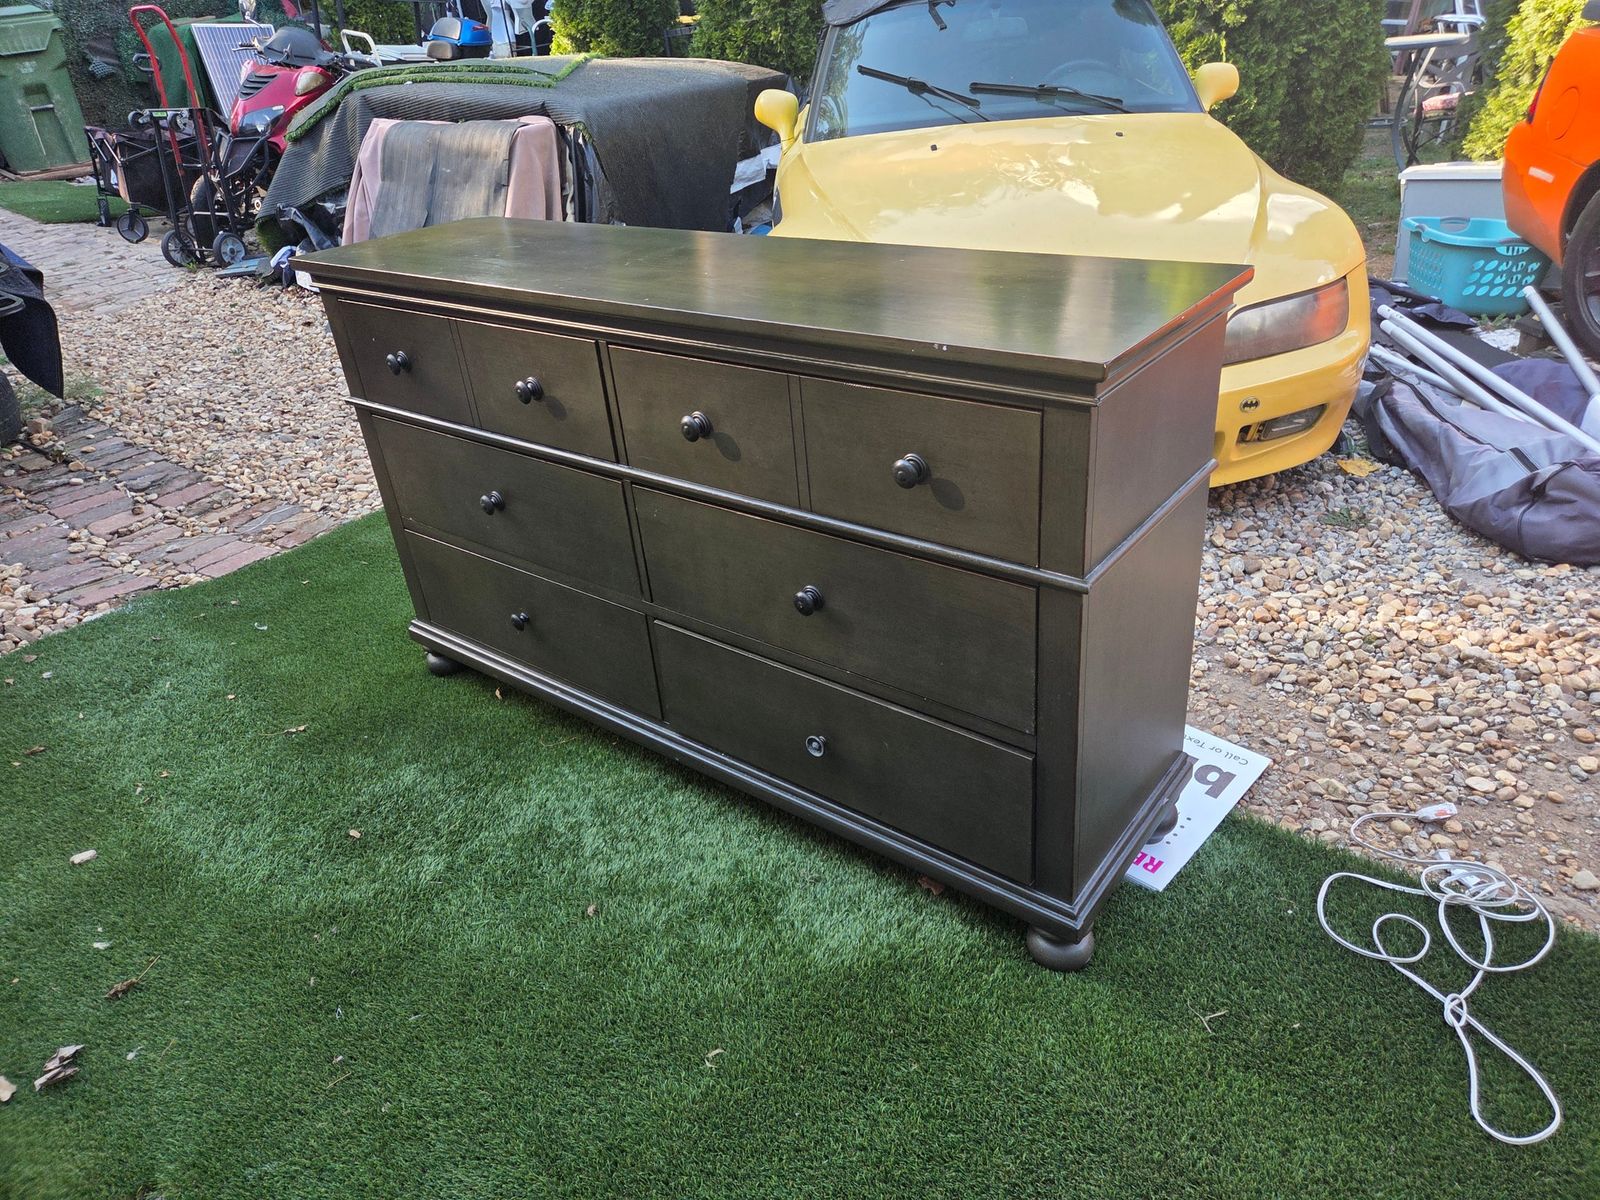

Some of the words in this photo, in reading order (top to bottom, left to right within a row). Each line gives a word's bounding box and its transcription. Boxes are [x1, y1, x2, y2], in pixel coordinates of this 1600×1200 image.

[1208, 746, 1222, 754] or
[1224, 751, 1249, 766] Call
[1187, 754, 1237, 799] b
